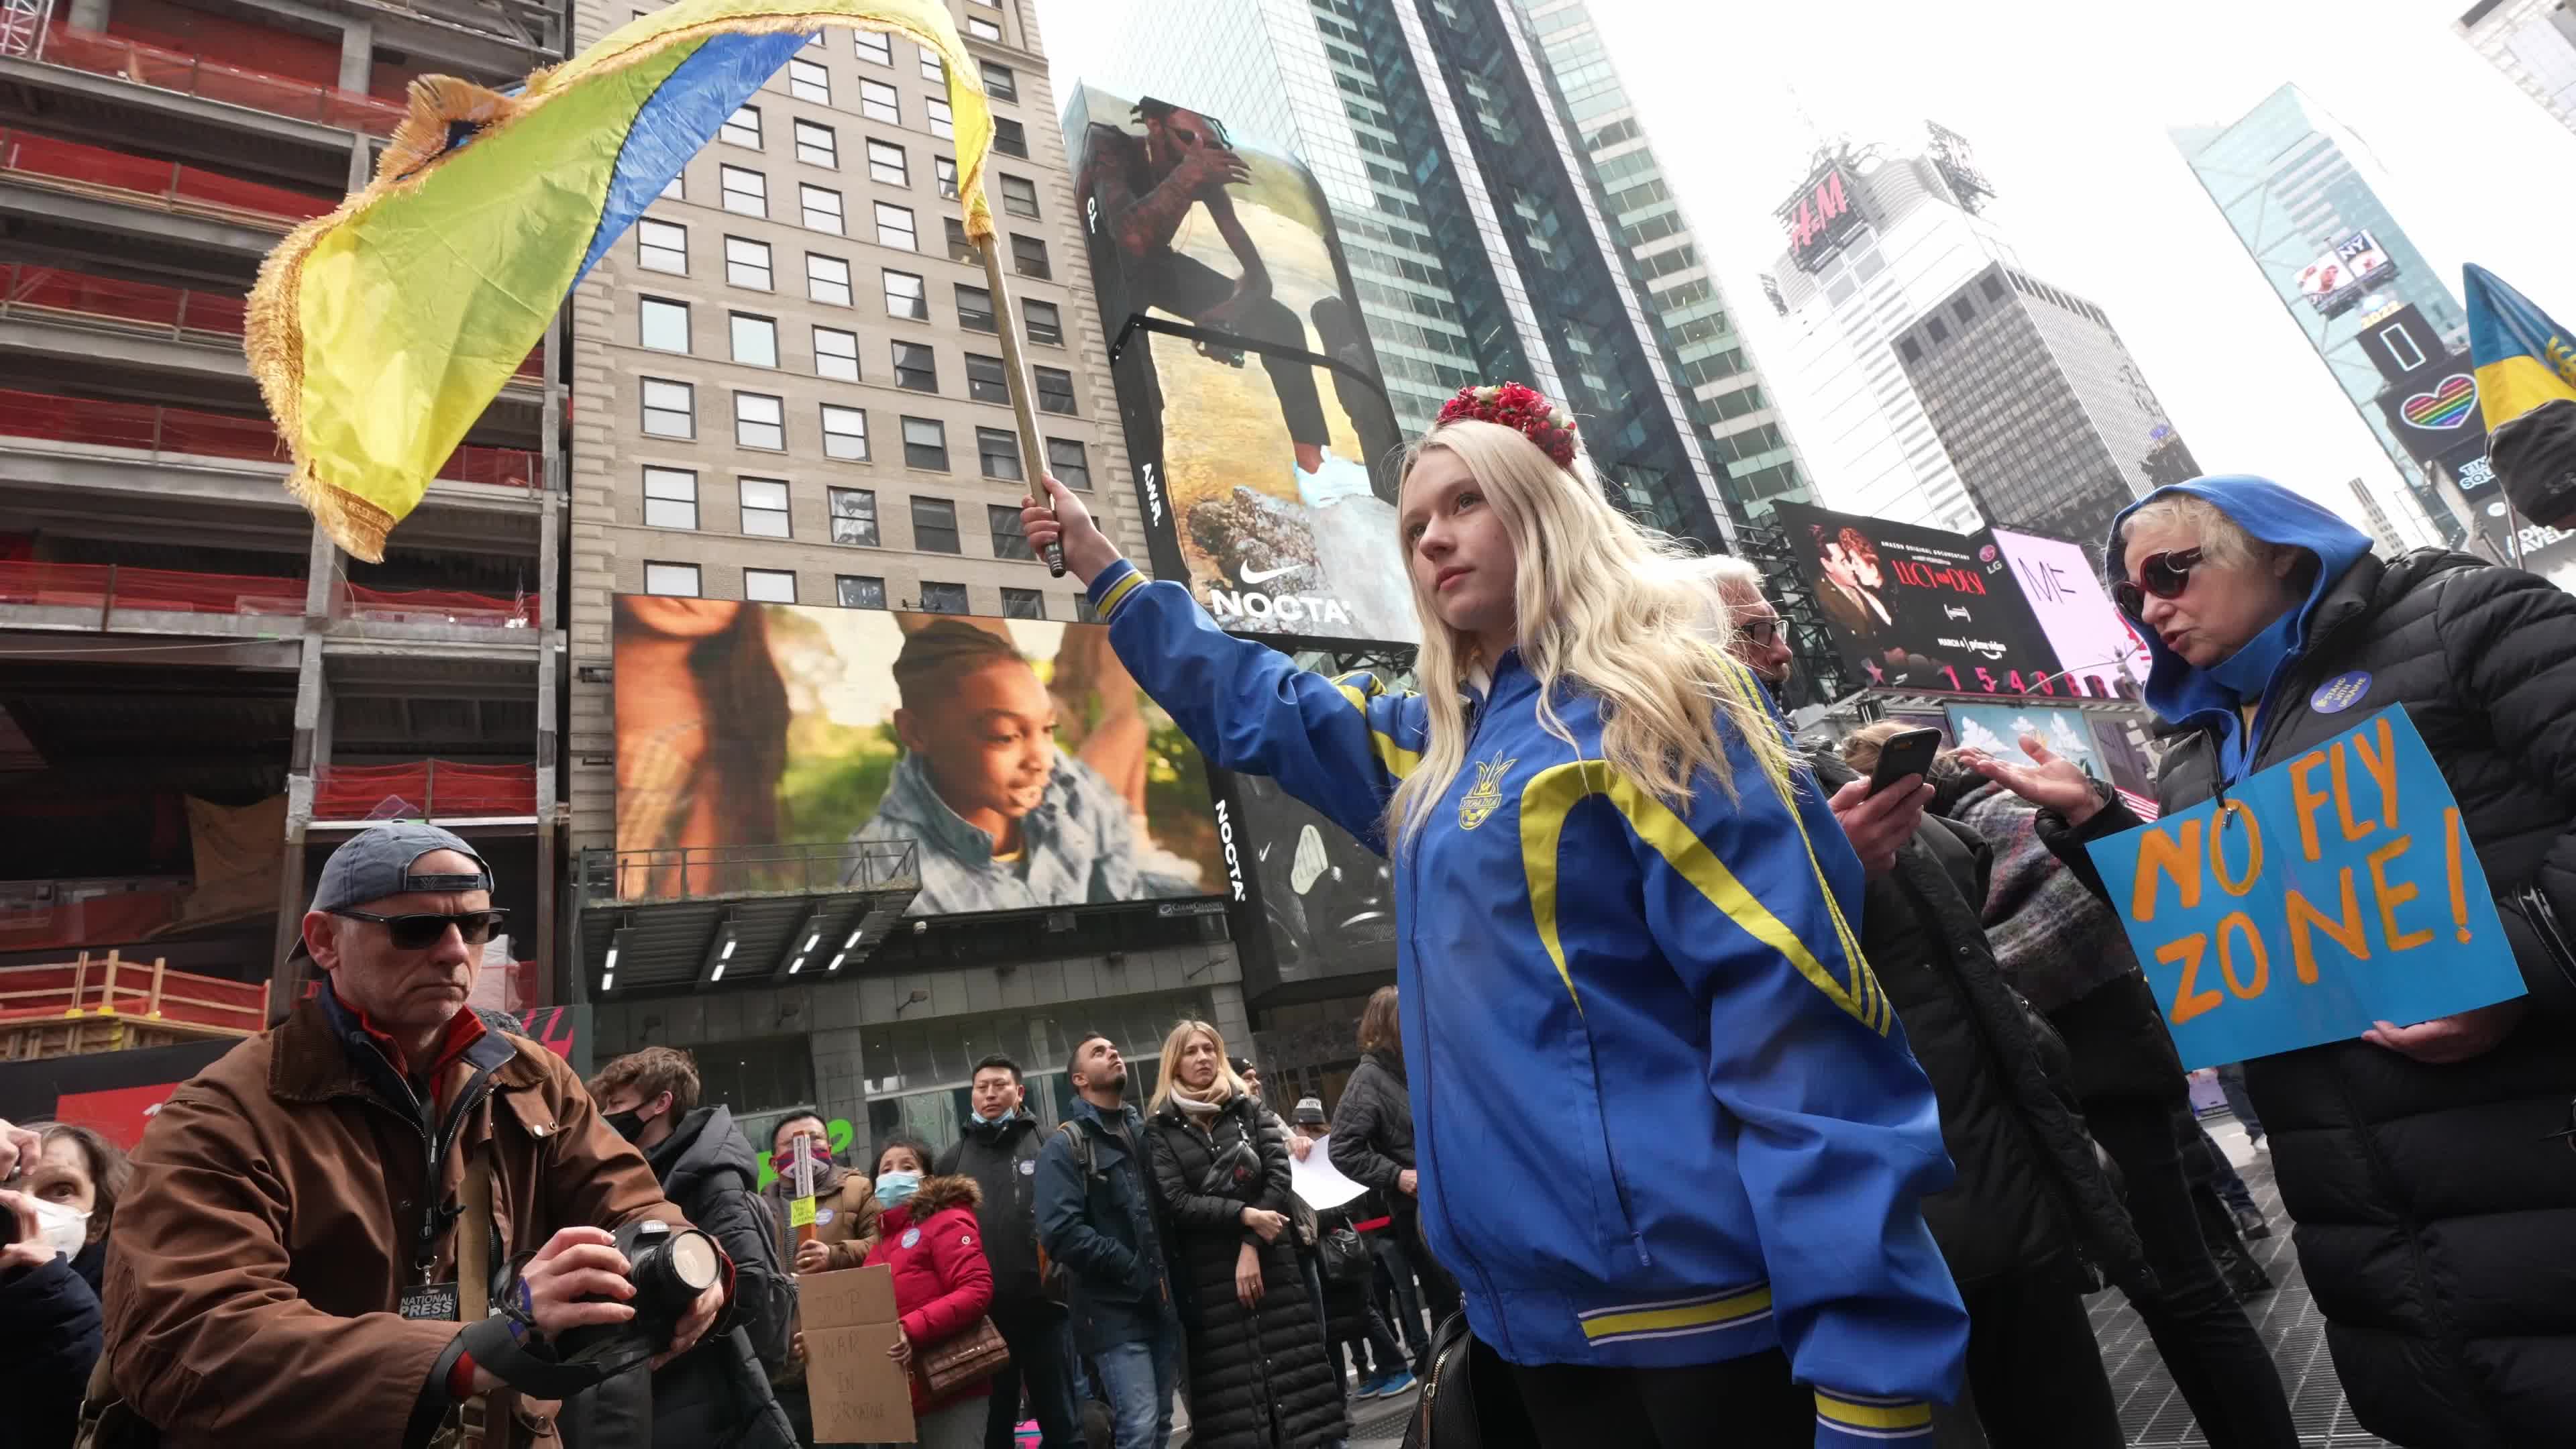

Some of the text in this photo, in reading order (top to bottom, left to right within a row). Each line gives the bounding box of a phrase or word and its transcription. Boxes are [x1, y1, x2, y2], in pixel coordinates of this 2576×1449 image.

[1792, 172, 1847, 256] H&M
[1892, 559, 1937, 588] LUCY
[1947, 568, 1986, 596] DESI
[1986, 560, 2002, 574] LG
[1943, 665, 2055, 696] 1540
[2131, 718, 2399, 922] NO FLY
[2155, 807, 2471, 1024] ZONE!
[398, 1301, 452, 1317] PRESS
[401, 1293, 454, 1305] NATIONAL
